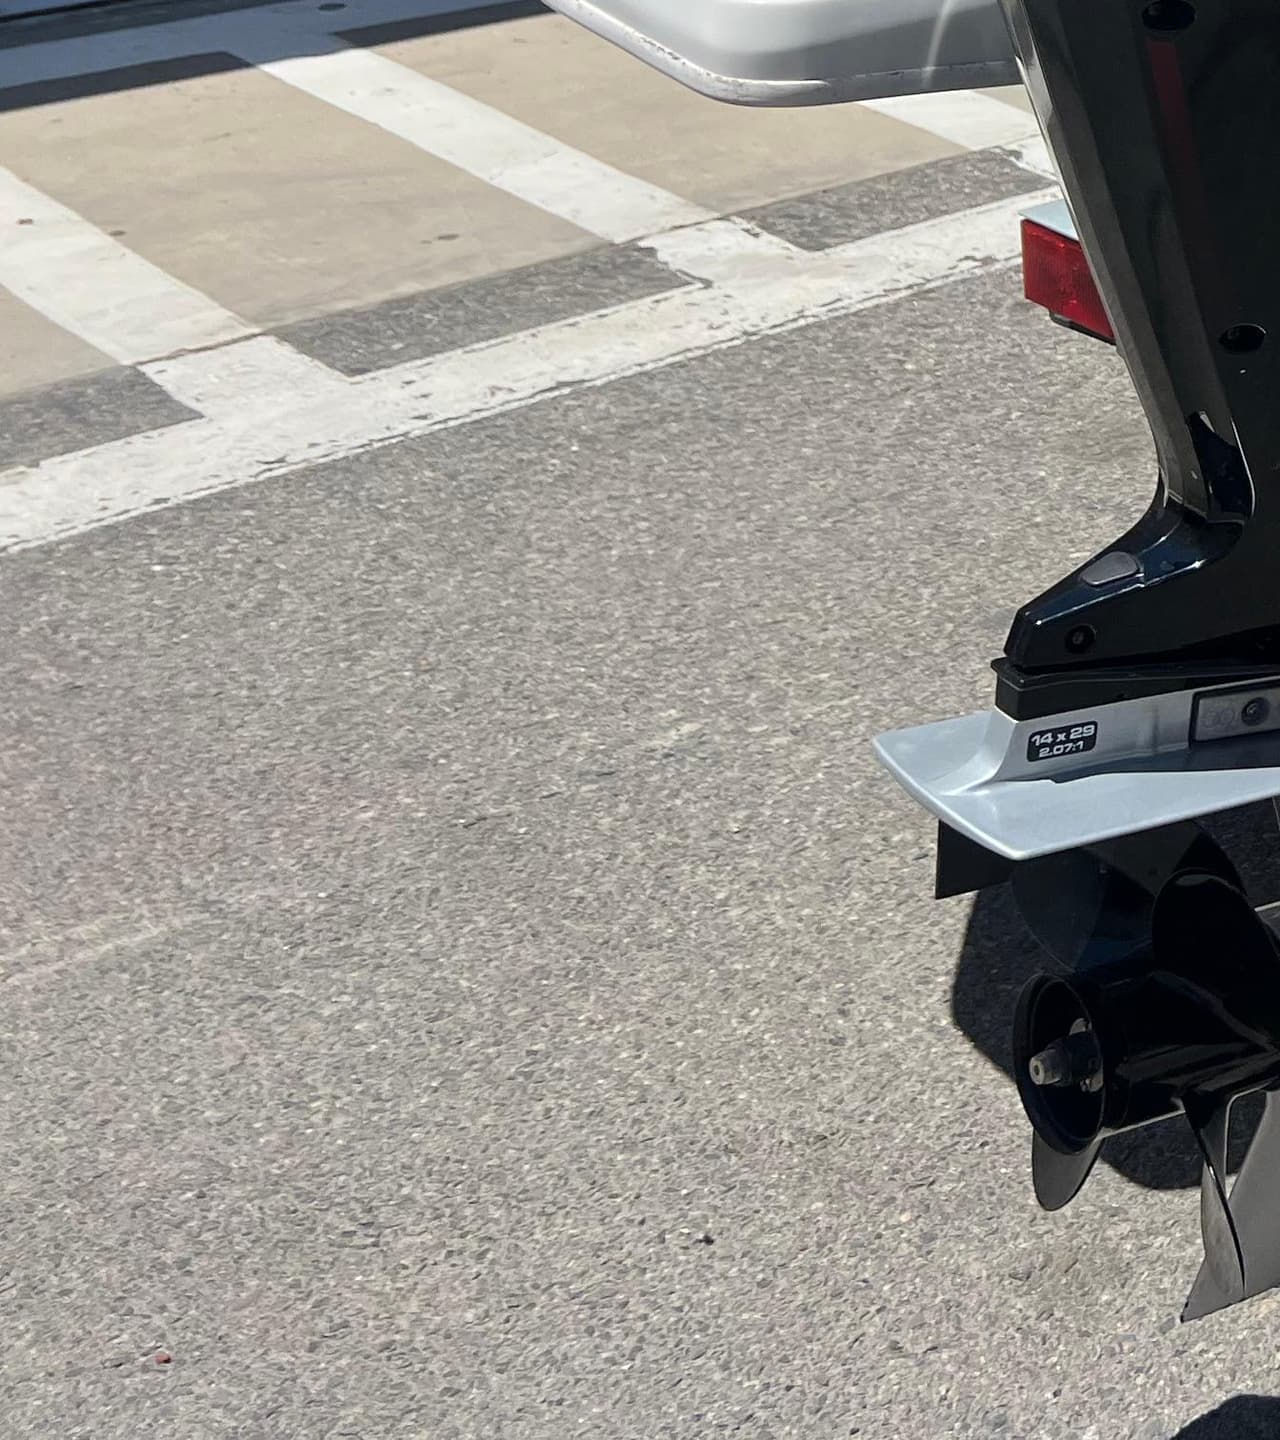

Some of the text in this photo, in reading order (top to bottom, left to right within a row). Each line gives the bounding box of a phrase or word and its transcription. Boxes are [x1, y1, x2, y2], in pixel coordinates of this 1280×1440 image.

[1031, 725, 1095, 746] 14 x 29
[1039, 740, 1084, 758] 2.07:1
